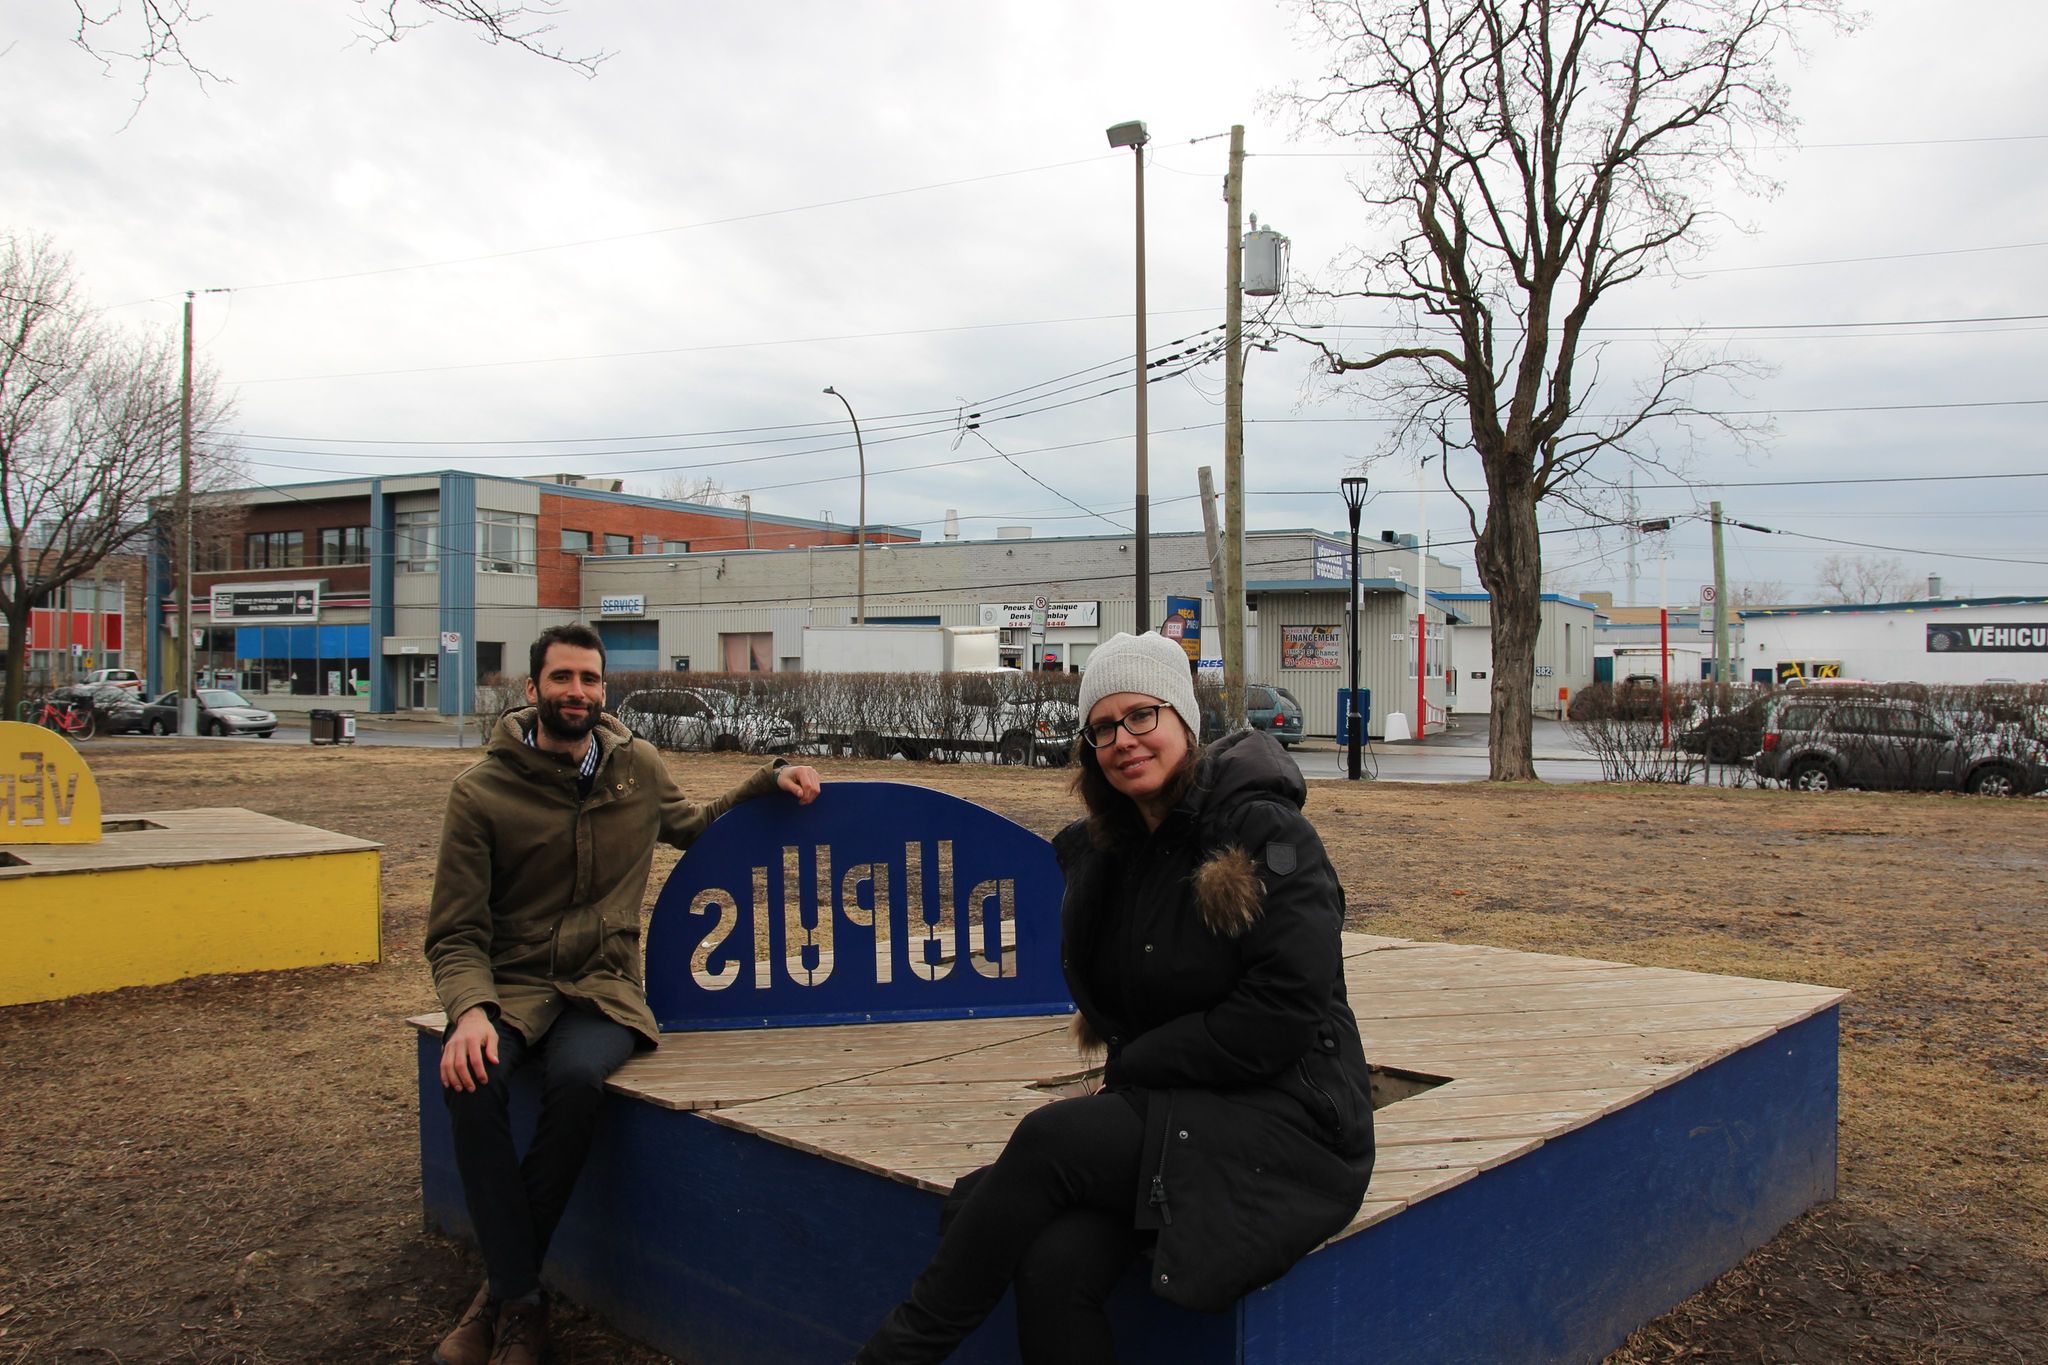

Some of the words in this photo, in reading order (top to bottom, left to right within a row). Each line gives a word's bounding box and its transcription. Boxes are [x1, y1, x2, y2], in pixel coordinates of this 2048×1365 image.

[602, 600, 639, 612] SERVICE
[1048, 604, 1078, 612] canique
[1285, 633, 1339, 642] FINANCEMENT
[1315, 649, 1339, 657] Chance
[1196, 659, 1224, 667] IRES
